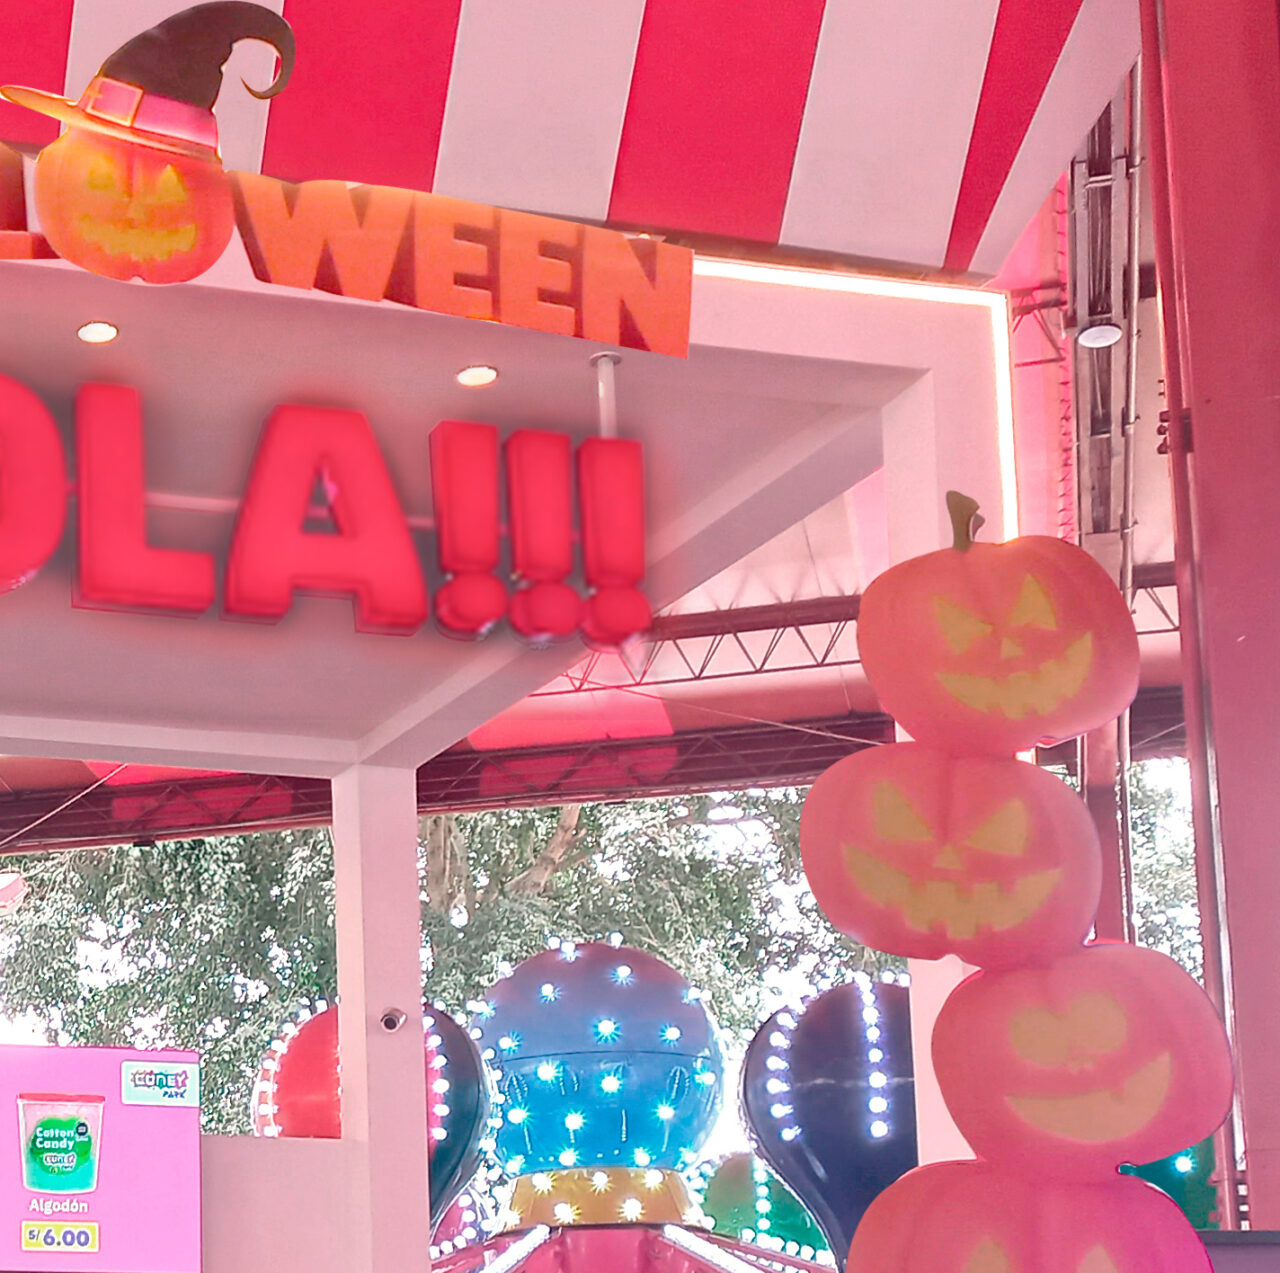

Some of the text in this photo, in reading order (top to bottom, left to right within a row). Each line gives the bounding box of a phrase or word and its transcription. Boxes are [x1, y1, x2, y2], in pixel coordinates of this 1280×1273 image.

[35, 1126, 75, 1138] Cotton
[35, 1137, 75, 1151] Candy
[28, 1197, 89, 1215] Algodón
[42, 1228, 91, 1247] 6.00
